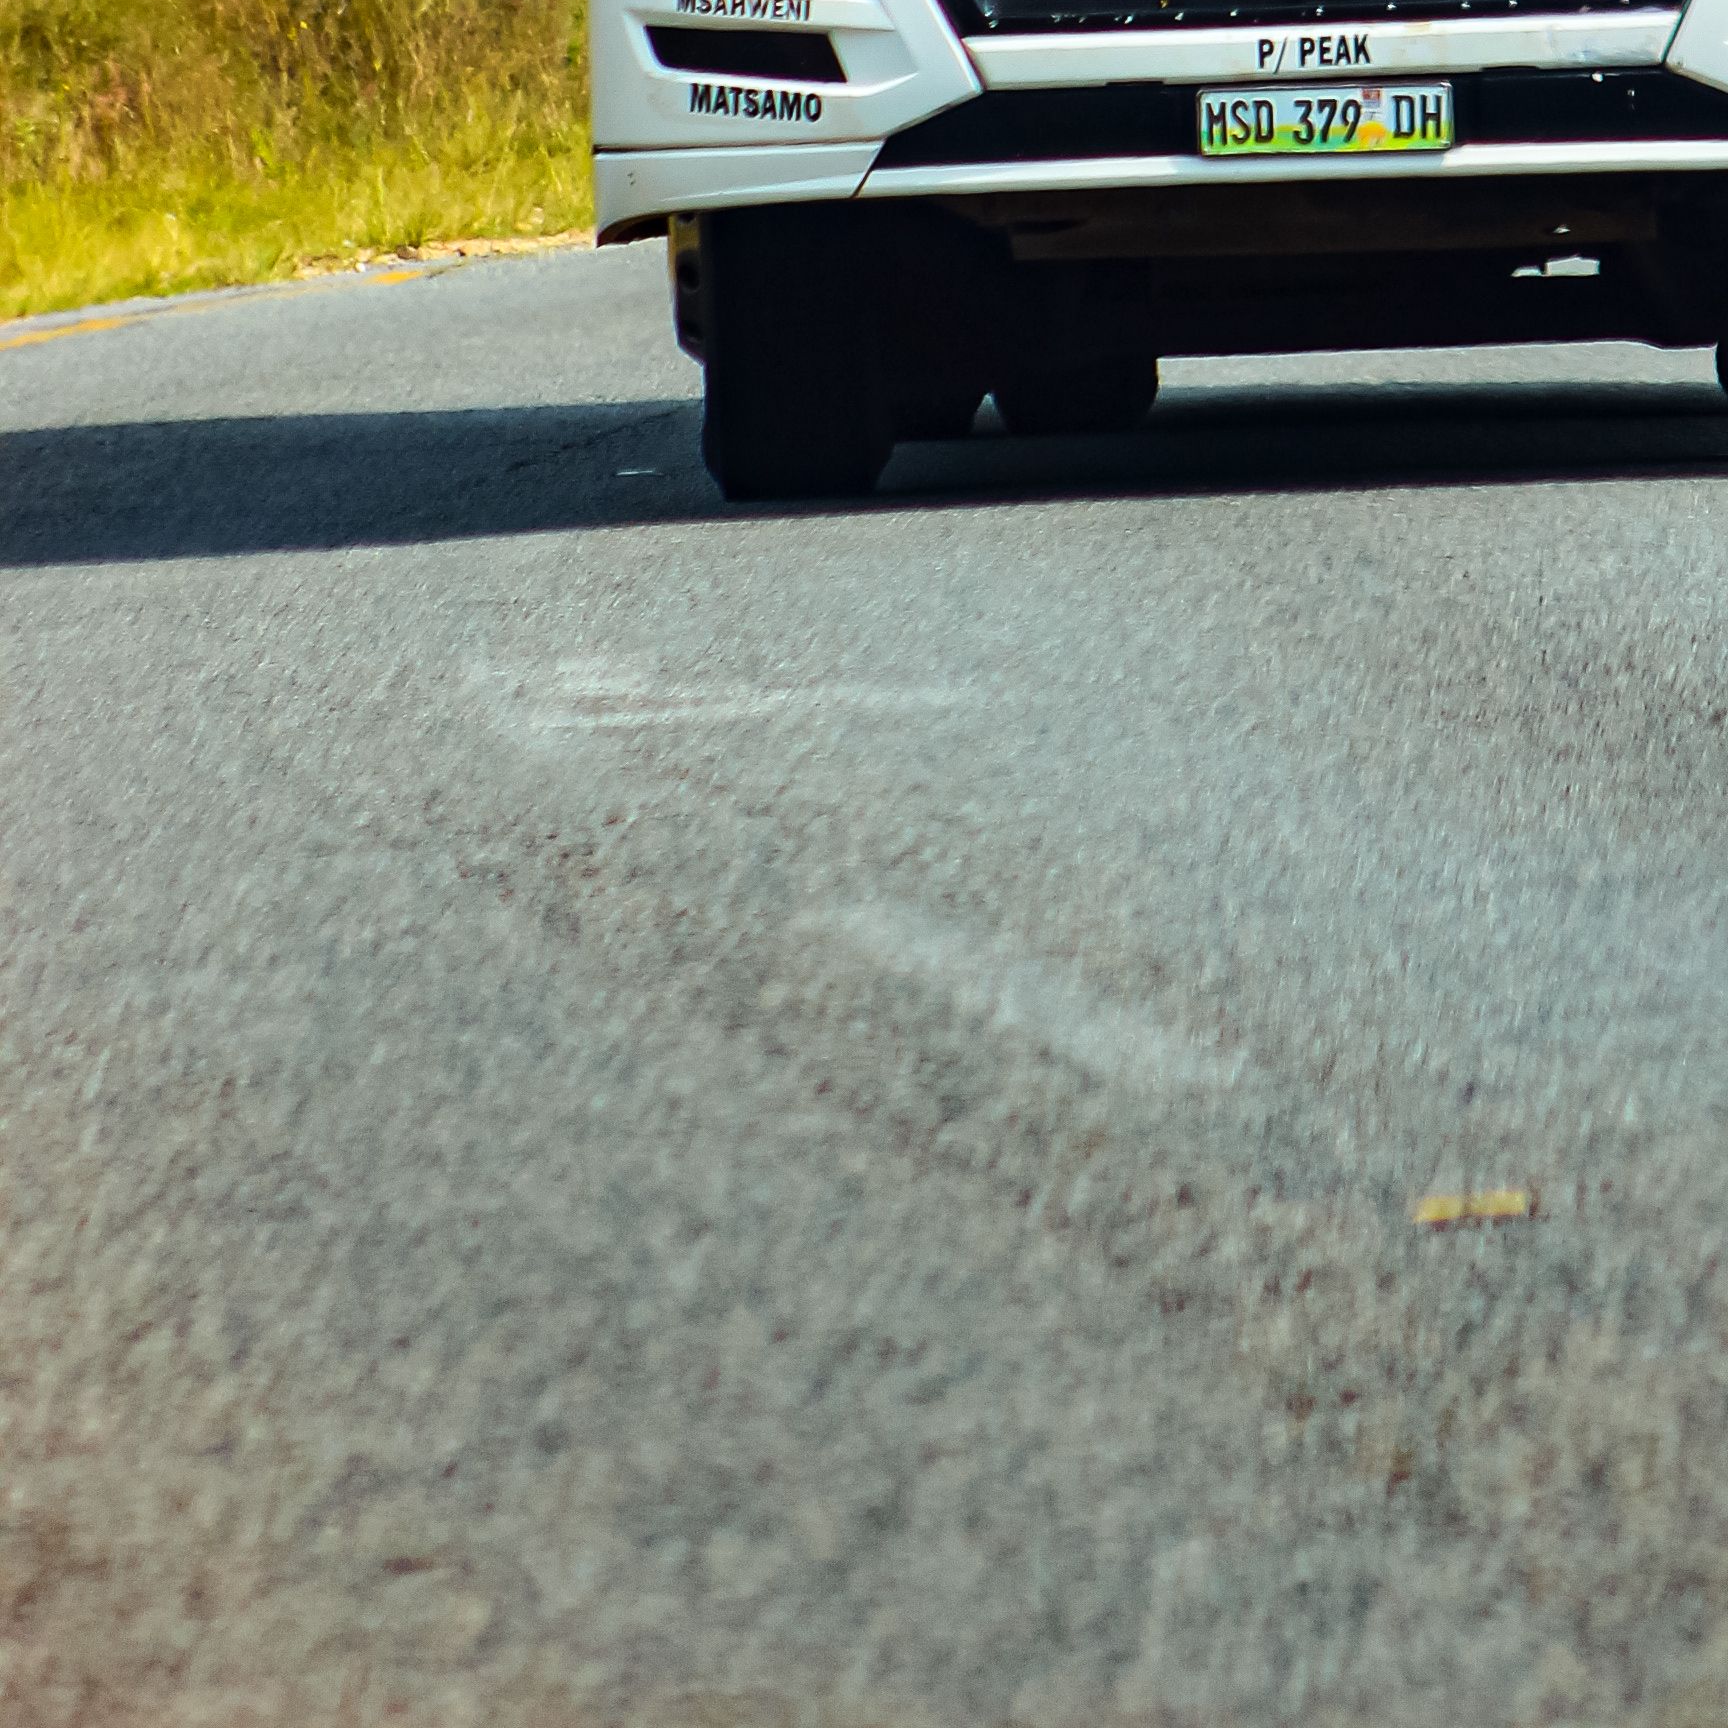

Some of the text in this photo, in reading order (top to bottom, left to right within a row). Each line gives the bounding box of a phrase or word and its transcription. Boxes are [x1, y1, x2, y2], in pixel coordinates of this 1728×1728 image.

[1298, 33, 1372, 69] PEAK
[690, 82, 823, 124] MATSAMO
[1205, 99, 1275, 147] MSD
[1292, 97, 1362, 146] 379
[1391, 94, 1443, 139] DH
